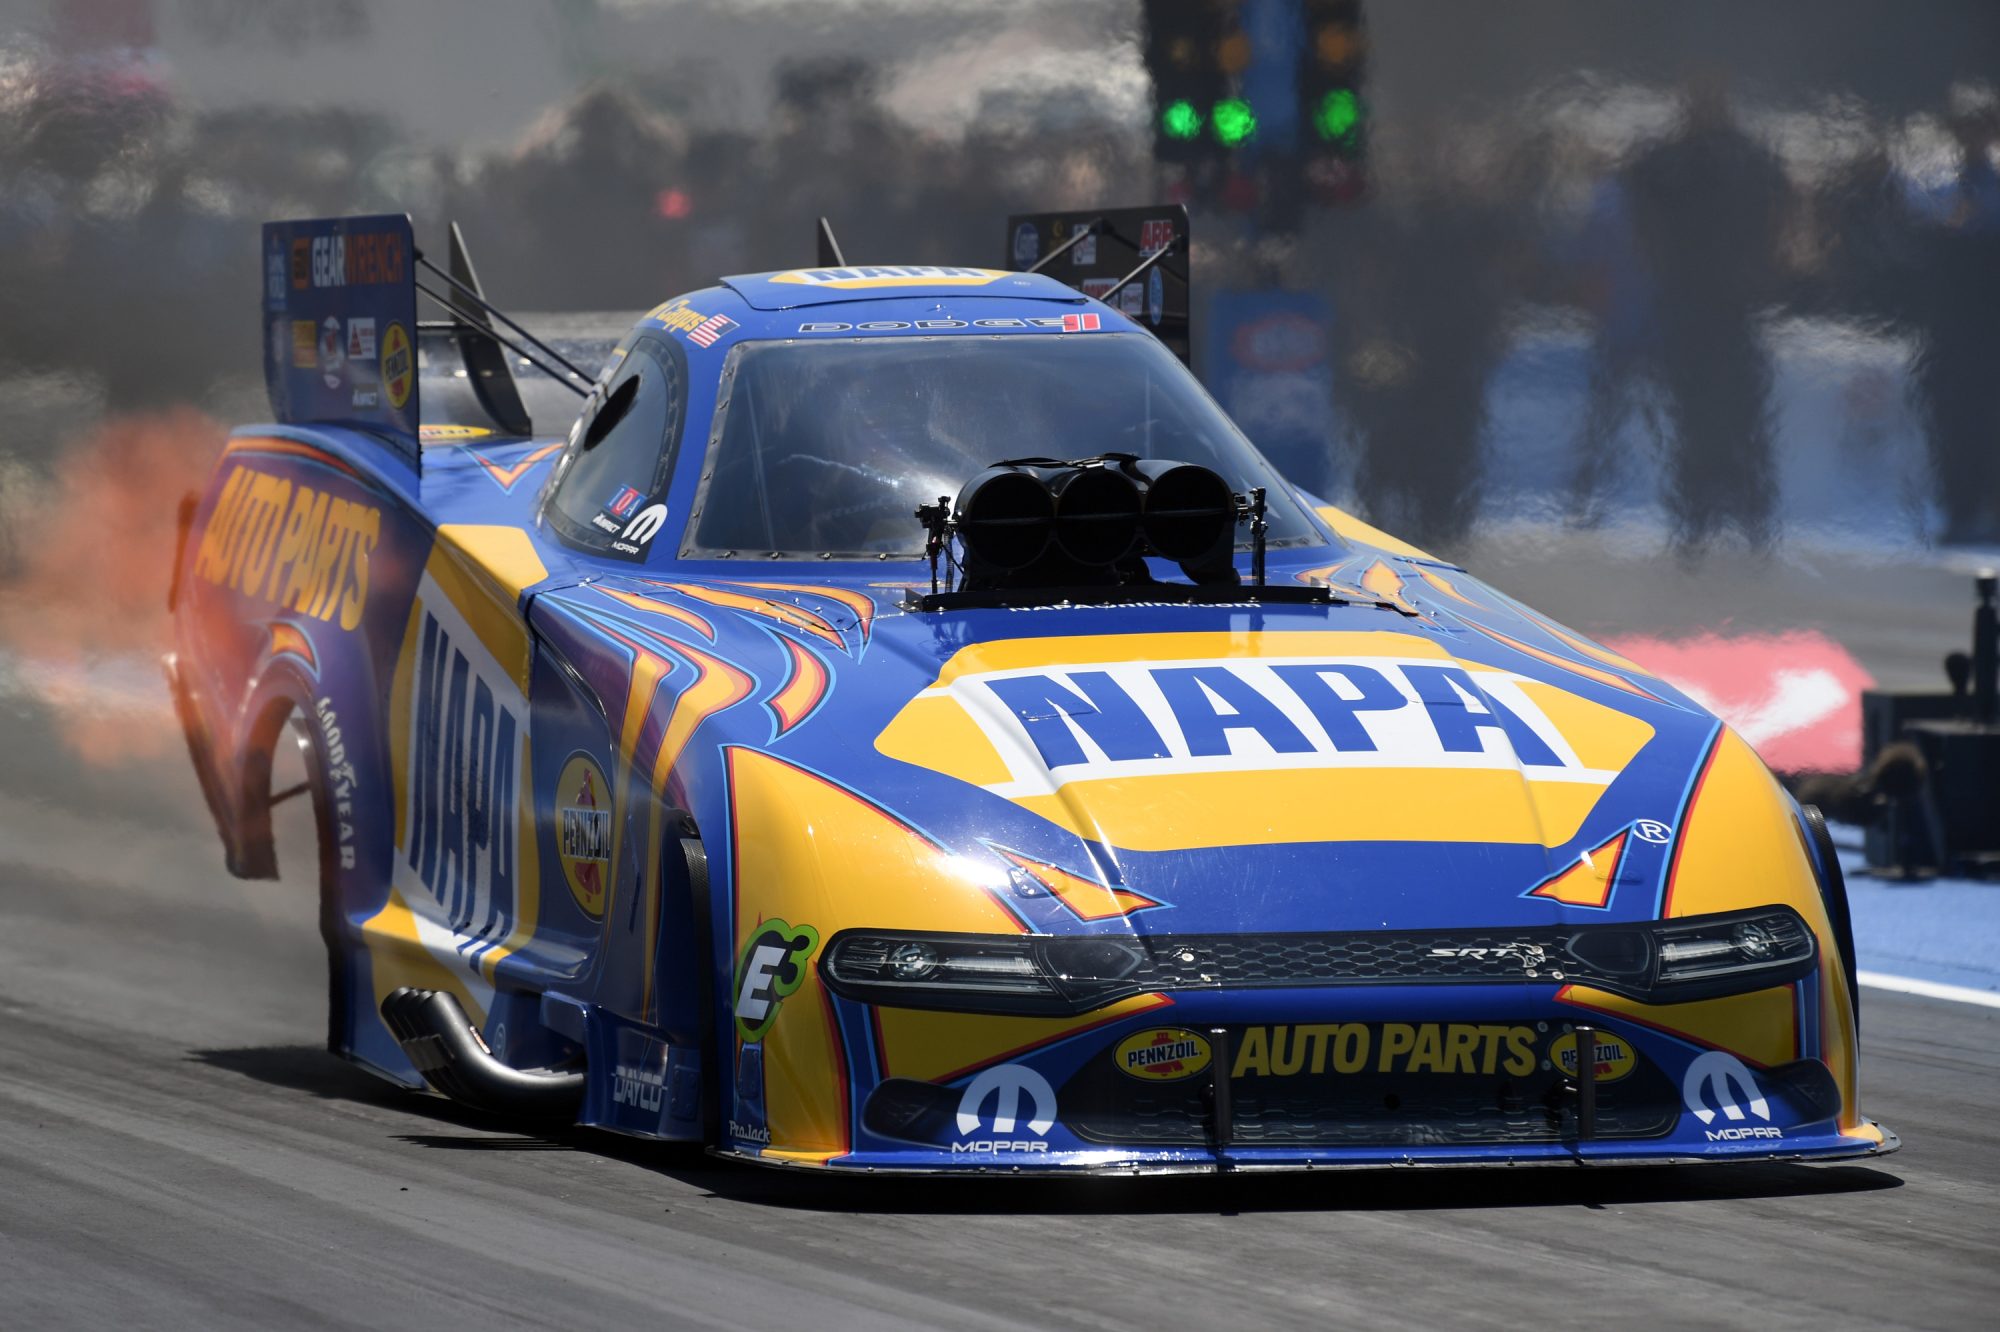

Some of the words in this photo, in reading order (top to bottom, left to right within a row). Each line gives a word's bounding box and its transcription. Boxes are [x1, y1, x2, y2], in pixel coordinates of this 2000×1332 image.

[805, 266, 985, 281] NAPA
[798, 318, 1075, 333] DODGE
[194, 464, 292, 597] AUTO
[265, 485, 381, 631] PARTS
[611, 541, 640, 555] MOPAR
[985, 663, 1568, 770] NAPA
[316, 696, 358, 870] GOODYEAR
[408, 610, 516, 974] NAPA
[1426, 948, 1518, 960] SRT
[1127, 1040, 1199, 1068] PENNZOIL
[1232, 1023, 1373, 1078] AUTO
[1378, 1023, 1538, 1077] PARTS
[1561, 1044, 1624, 1067] PEZOIL
[612, 1064, 665, 1113] DAYCO
[952, 1140, 1049, 1153] MOPAR
[1704, 1127, 1784, 1141] MOPAR
